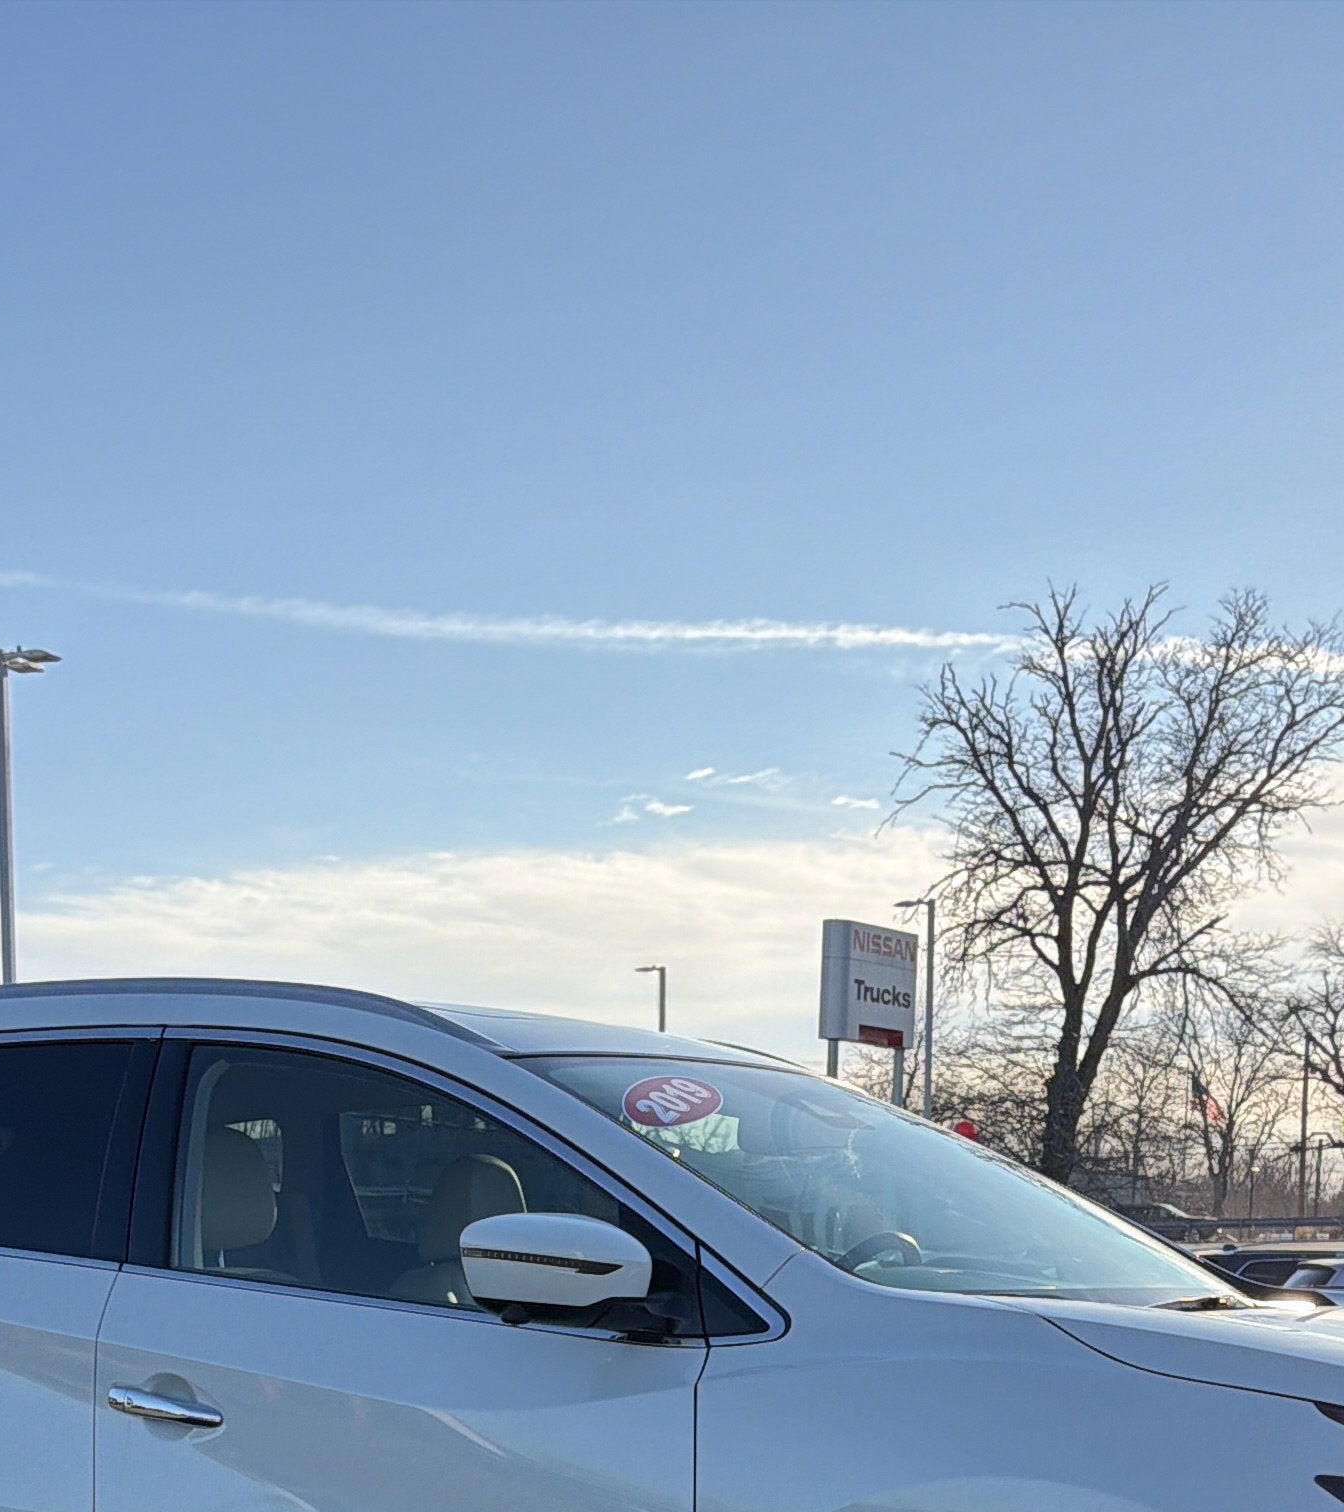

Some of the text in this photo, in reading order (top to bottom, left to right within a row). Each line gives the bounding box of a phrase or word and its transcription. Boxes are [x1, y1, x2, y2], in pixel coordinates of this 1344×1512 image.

[853, 929, 916, 962] NISSAN
[854, 979, 911, 1009] Trucks
[635, 1079, 712, 1124] 2019
